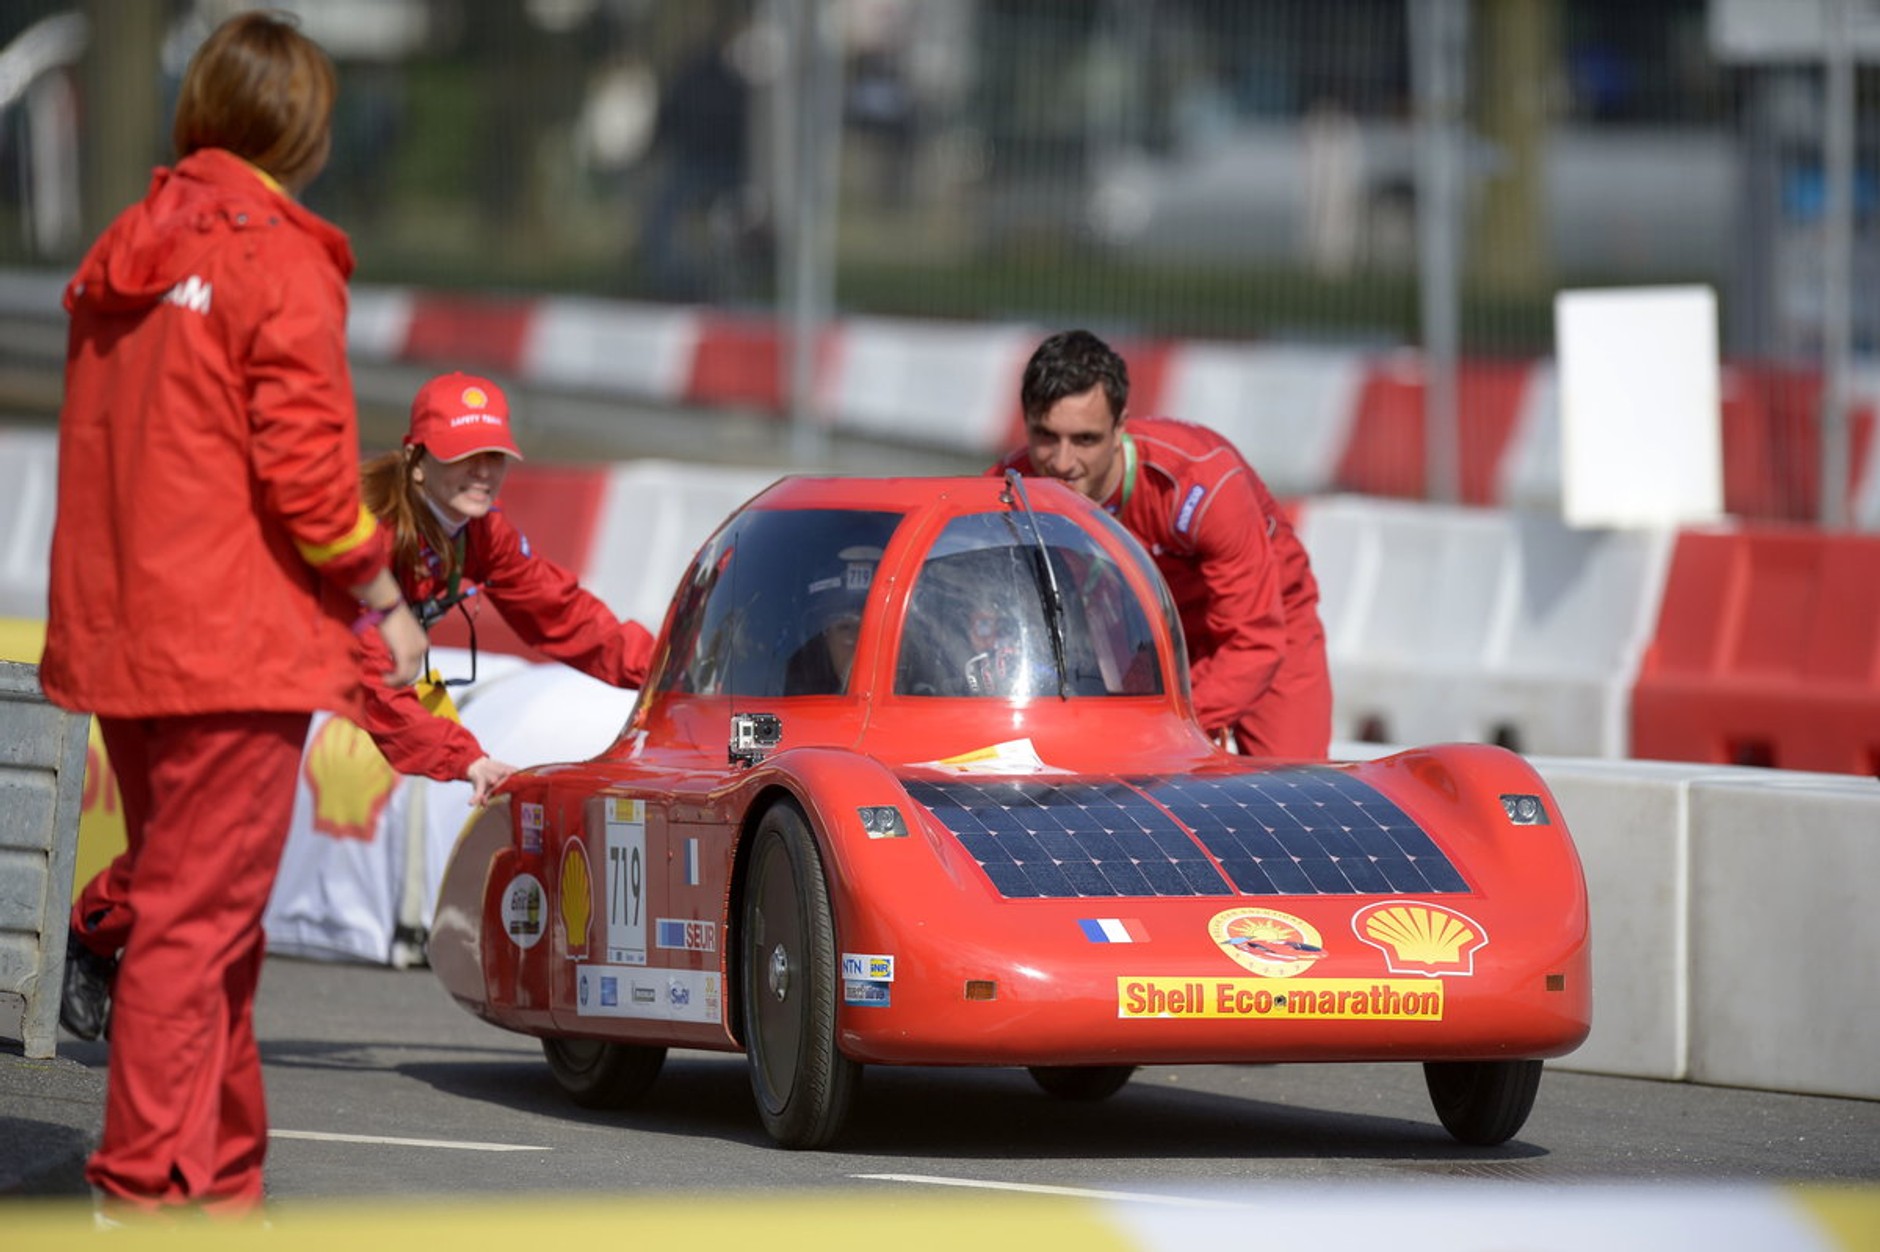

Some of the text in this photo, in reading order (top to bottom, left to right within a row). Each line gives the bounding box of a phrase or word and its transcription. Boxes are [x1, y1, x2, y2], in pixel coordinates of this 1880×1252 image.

[610, 846, 641, 927] 719
[686, 922, 714, 949] SEUR
[843, 959, 862, 974] NTN
[1126, 982, 1440, 1014] Shell Ecomarathon
